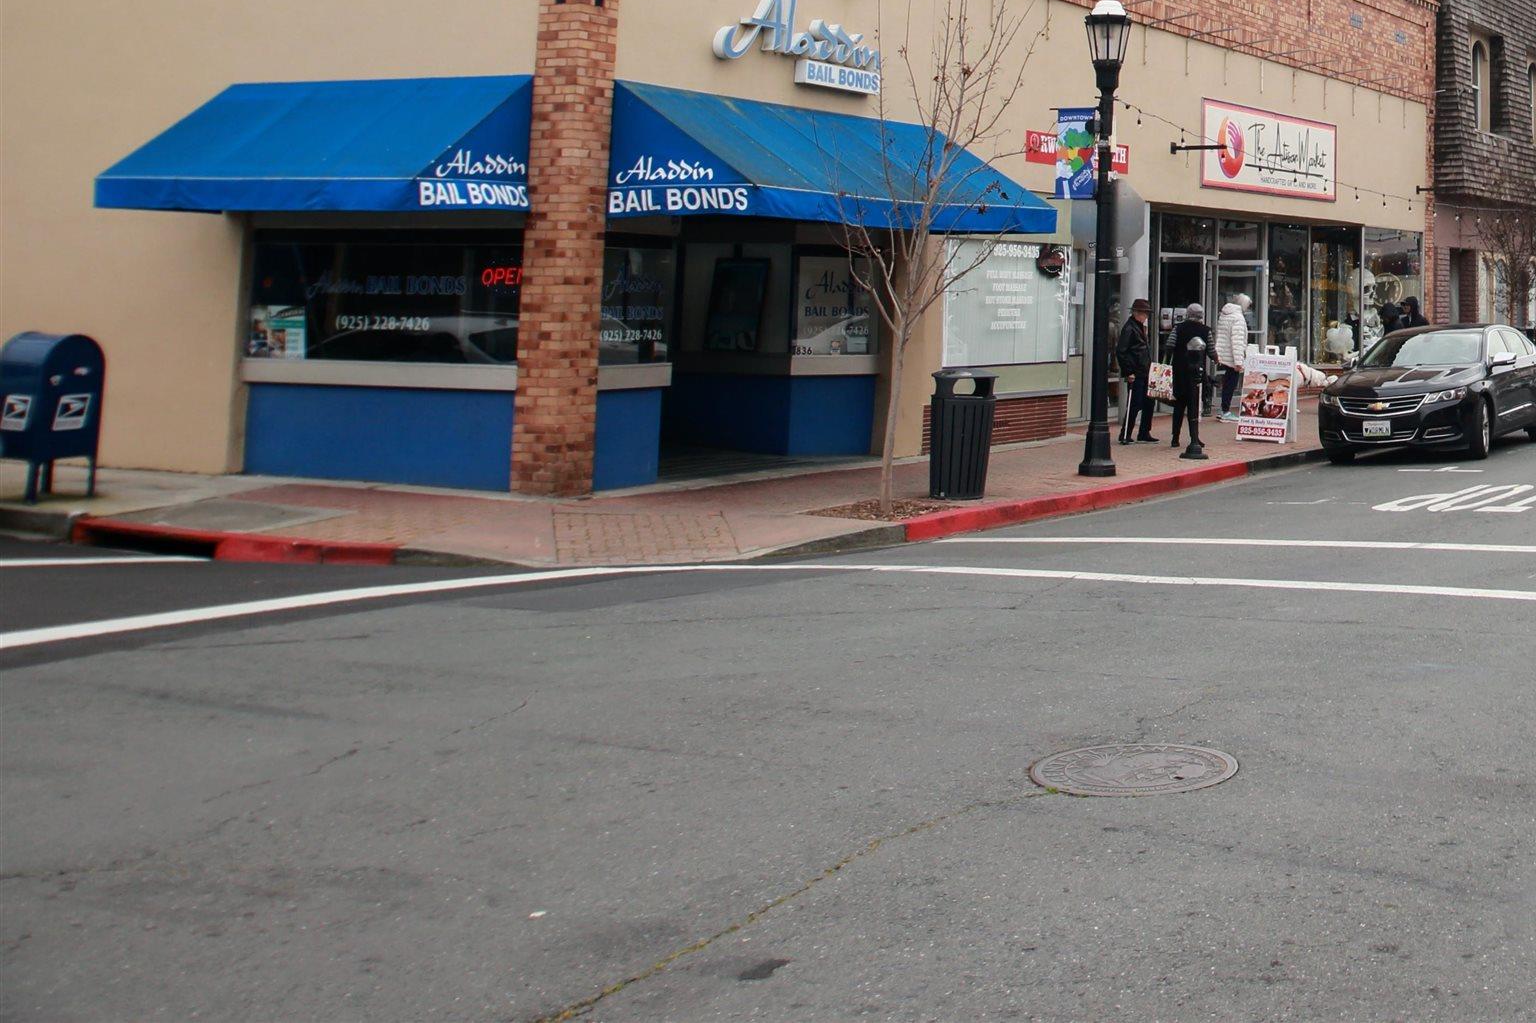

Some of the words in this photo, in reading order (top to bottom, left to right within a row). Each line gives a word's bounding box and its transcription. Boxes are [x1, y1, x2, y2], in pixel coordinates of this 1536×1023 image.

[807, 62, 835, 84] BAIL
[838, 69, 880, 91] BONDS
[1041, 135, 1058, 154] RW
[1248, 123, 1265, 164] The
[1298, 127, 1327, 179] Market
[436, 149, 526, 177] Aladdin
[616, 155, 714, 184] Aladdin
[420, 182, 467, 206] BAIL
[467, 183, 529, 207] BONDS
[609, 189, 661, 213] BAIL
[666, 187, 748, 211] BONDS
[336, 315, 368, 332] (925)
[373, 315, 430, 332] 228-7426
[805, 306, 829, 317] BAIL
[600, 329, 622, 342] (925)
[625, 329, 662, 342] 228-7426
